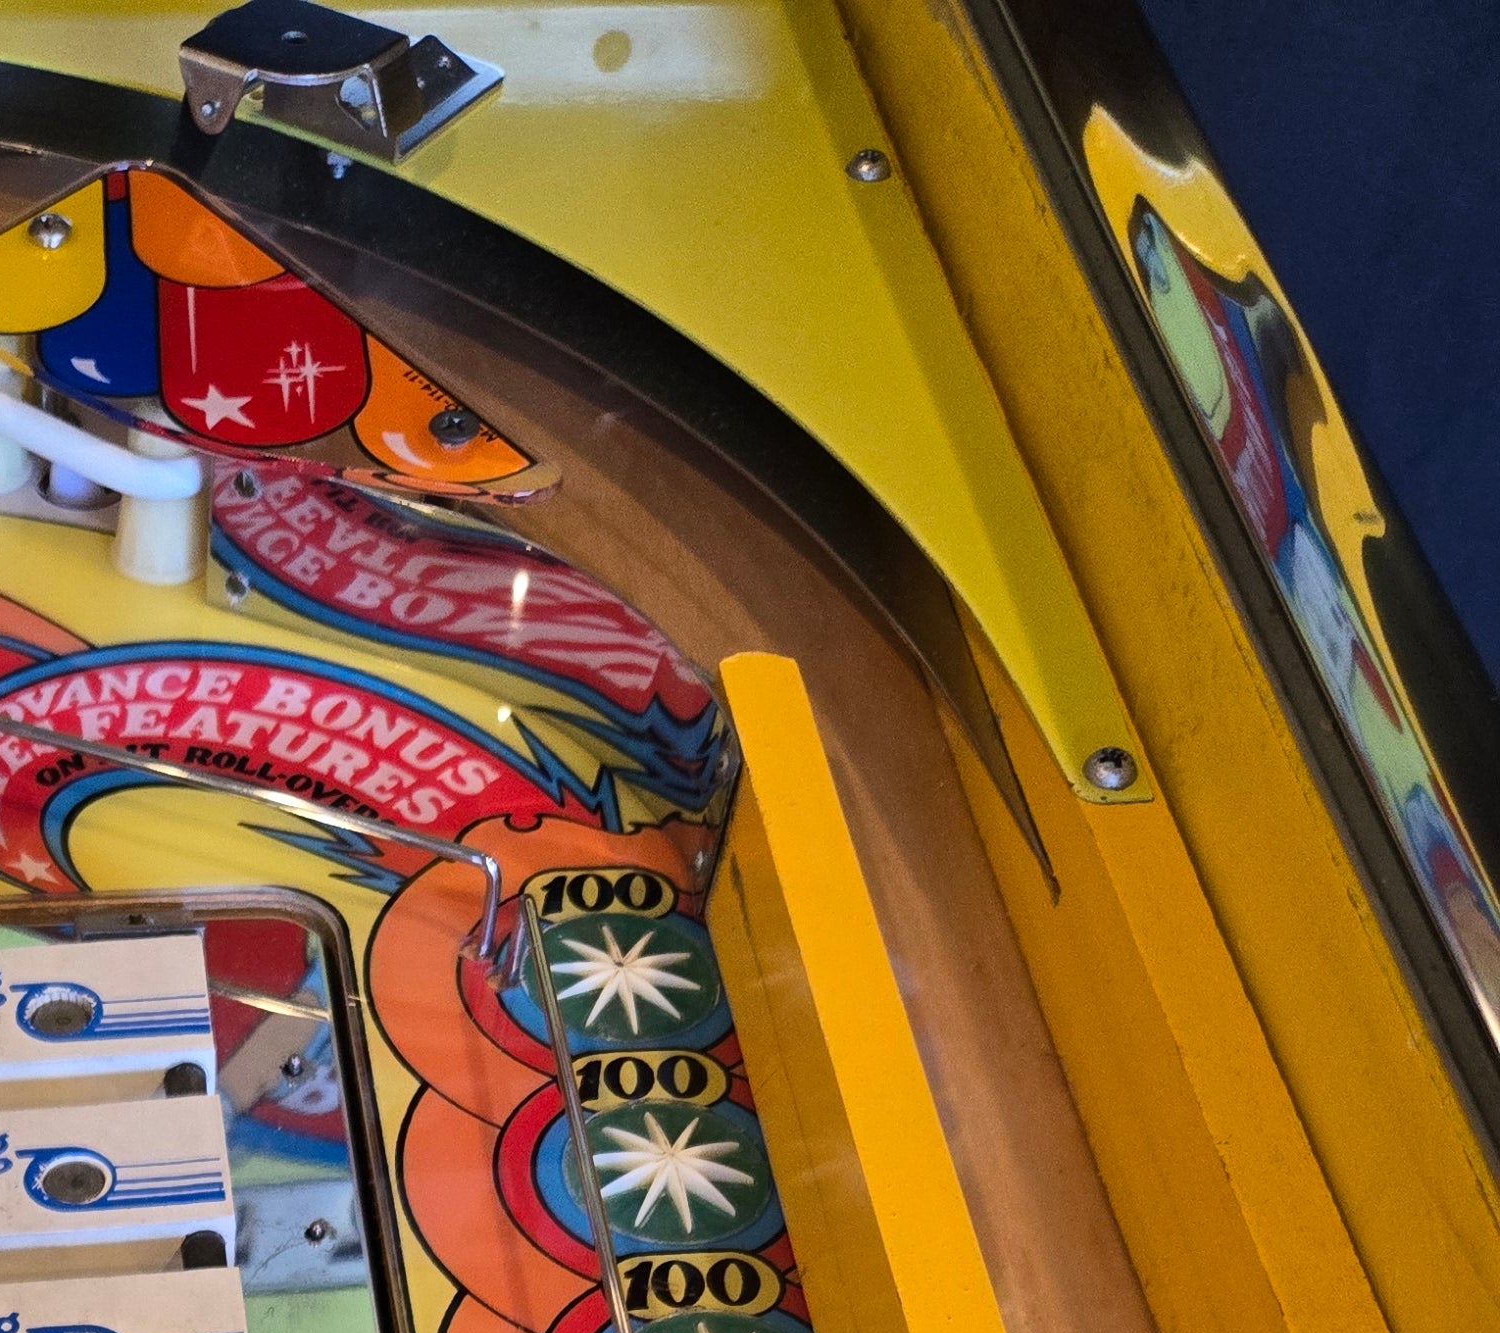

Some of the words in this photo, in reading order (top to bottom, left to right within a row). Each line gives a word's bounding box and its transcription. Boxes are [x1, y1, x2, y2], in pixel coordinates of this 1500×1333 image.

[267, 673, 502, 798] BONUS
[35, 752, 86, 787] ON
[77, 702, 457, 825] FEATURES
[540, 871, 663, 916] 100
[575, 1055, 709, 1101] 100
[622, 1257, 761, 1311] 100
